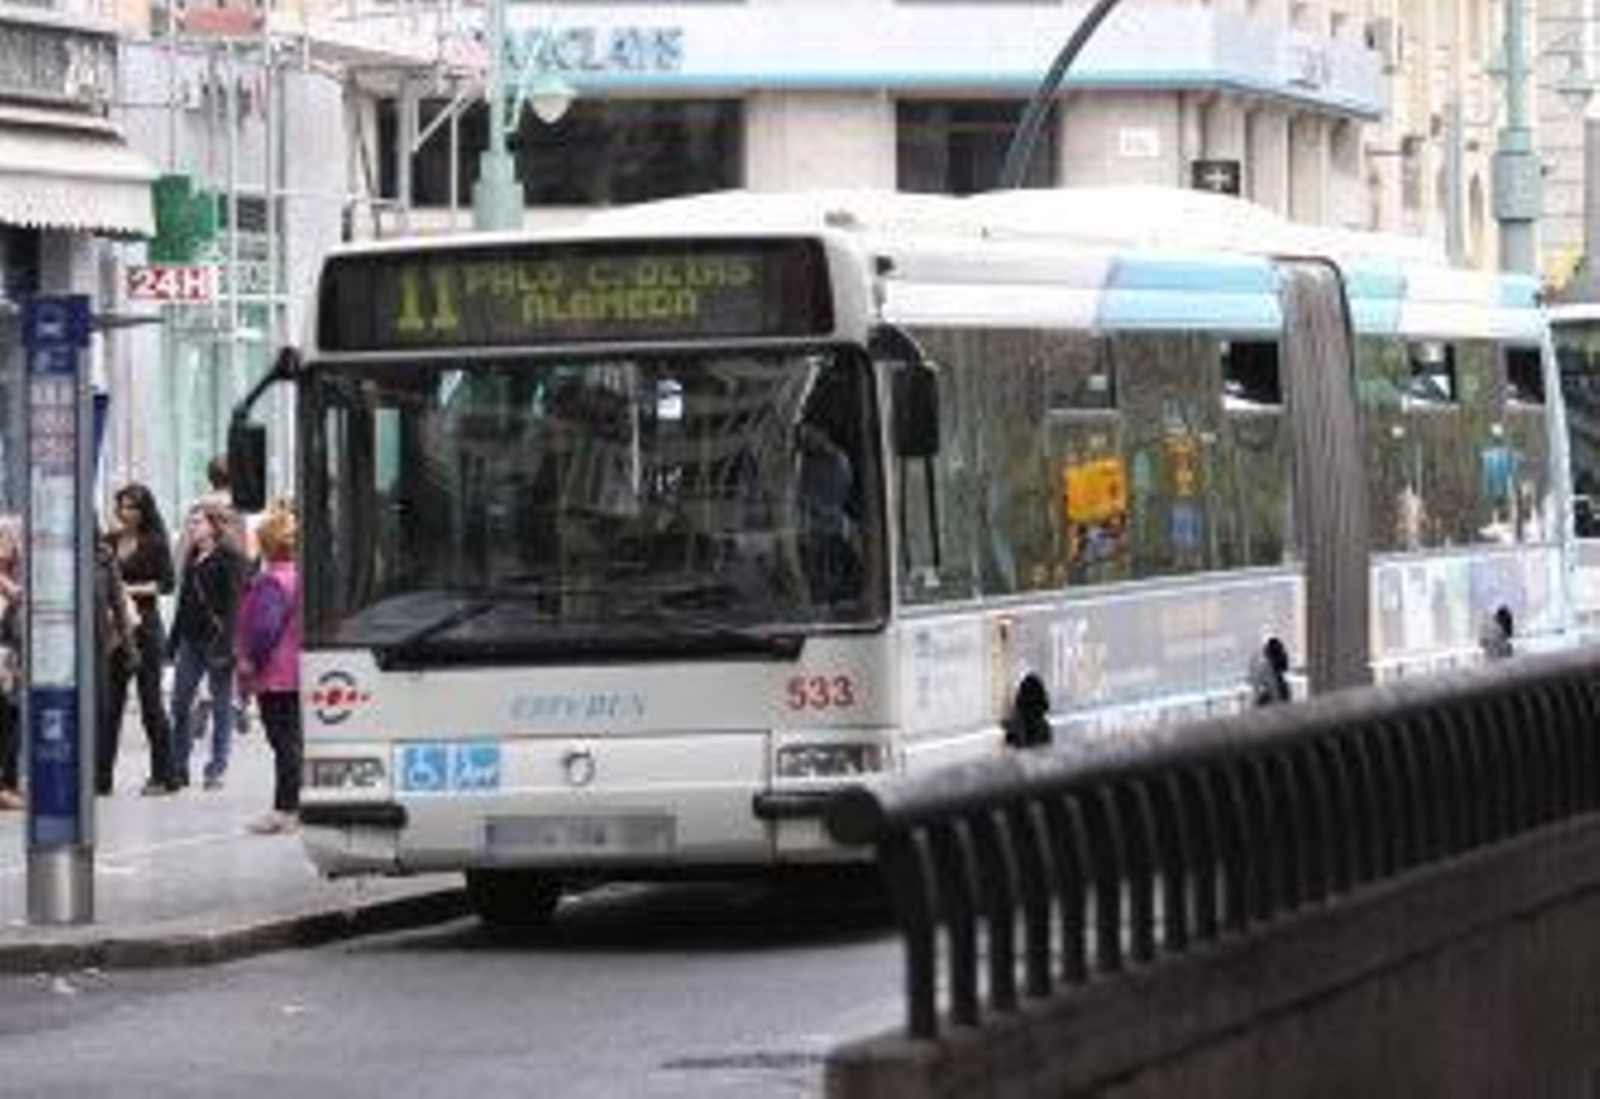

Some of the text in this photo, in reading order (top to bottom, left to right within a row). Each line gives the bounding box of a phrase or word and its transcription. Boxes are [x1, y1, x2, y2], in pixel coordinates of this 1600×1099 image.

[501, 27, 684, 70] ARCLAYS
[131, 266, 210, 299] 24H
[398, 265, 457, 329] 11
[463, 261, 564, 297] PALO
[522, 287, 699, 327] ALAMEDA
[786, 675, 854, 710] 533
